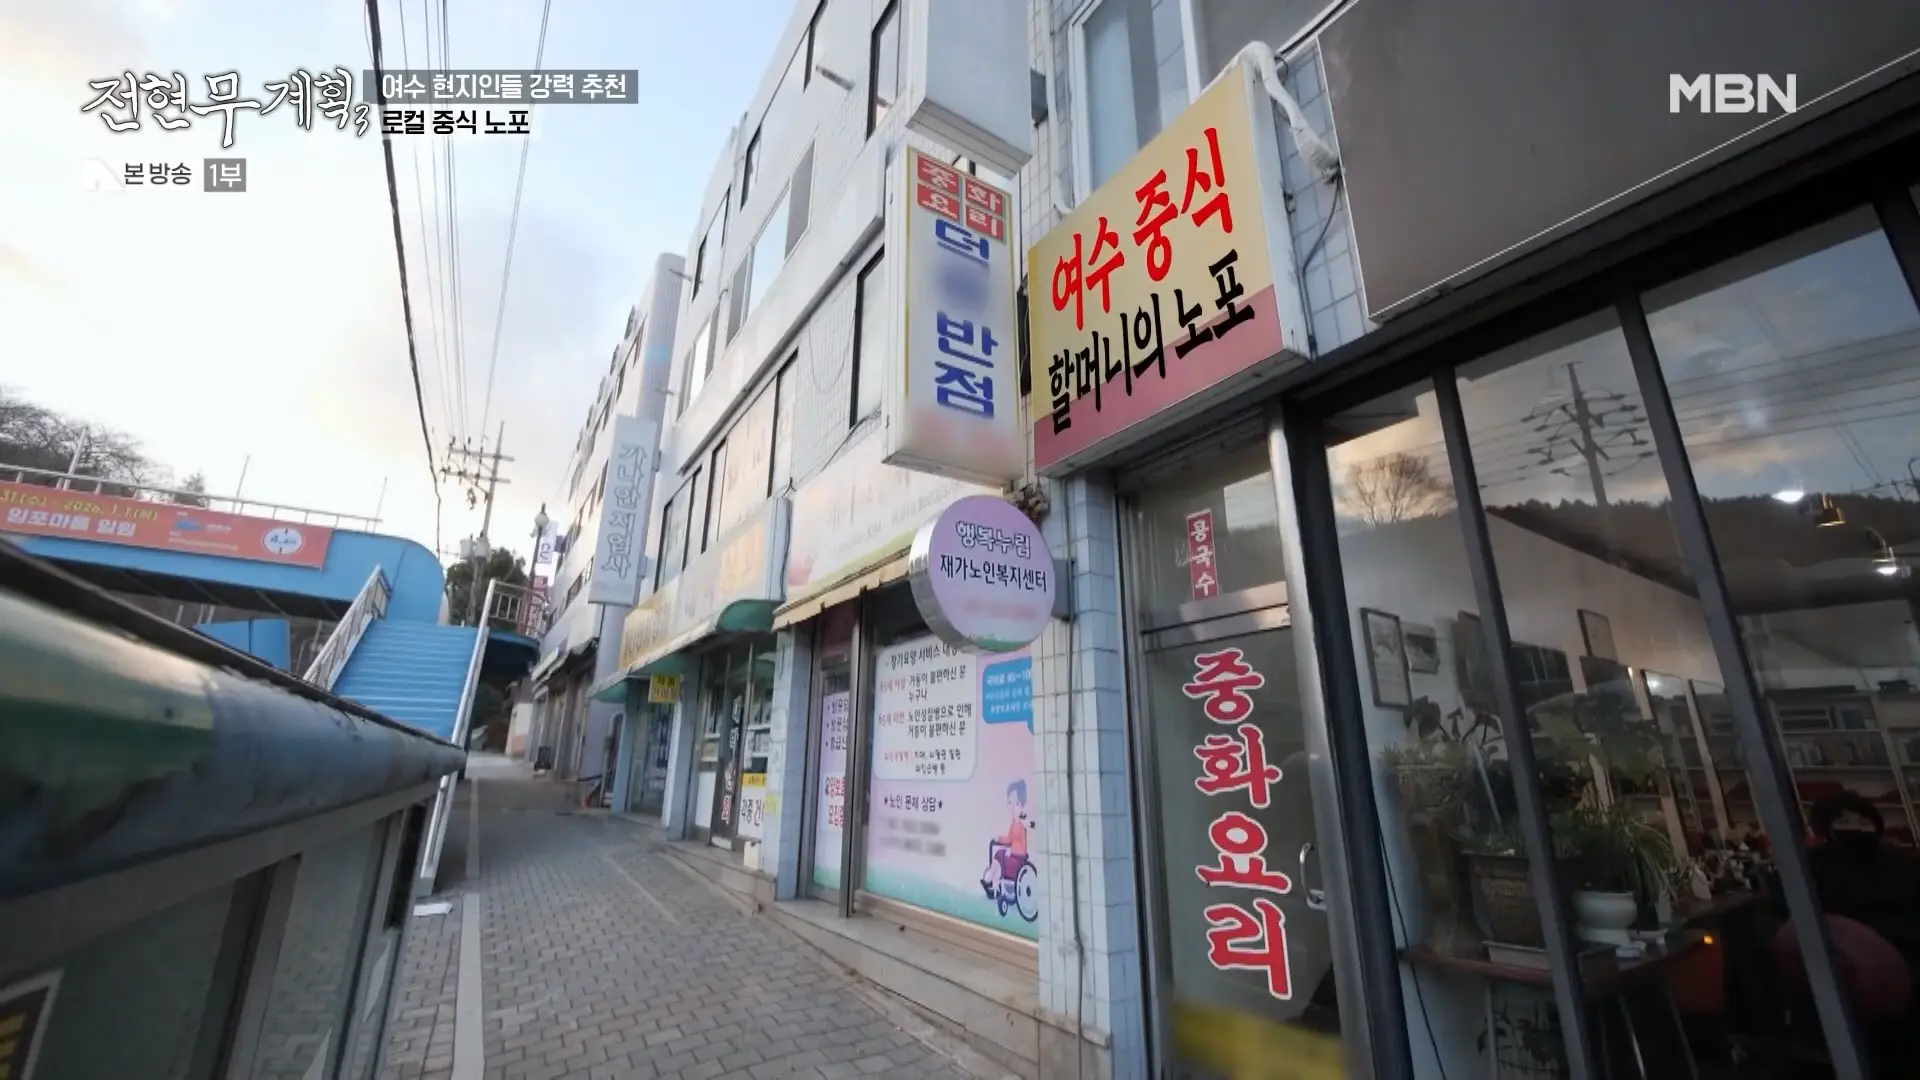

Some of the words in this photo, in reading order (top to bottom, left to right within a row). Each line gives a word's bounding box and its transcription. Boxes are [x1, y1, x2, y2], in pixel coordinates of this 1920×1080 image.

[1052, 216, 1125, 331] 여수
[1132, 127, 1233, 282] 중식
[1048, 291, 1166, 435] 할머니의
[1174, 249, 1255, 359] 노포
[956, 521, 1031, 559] 행복누림
[940, 554, 1047, 592] 재가노인복지센터
[919, 644, 940, 662] 서비스
[909, 688, 927, 703] 누구나
[957, 703, 972, 718] 인해
[1183, 648, 1292, 1000] 중화요리
